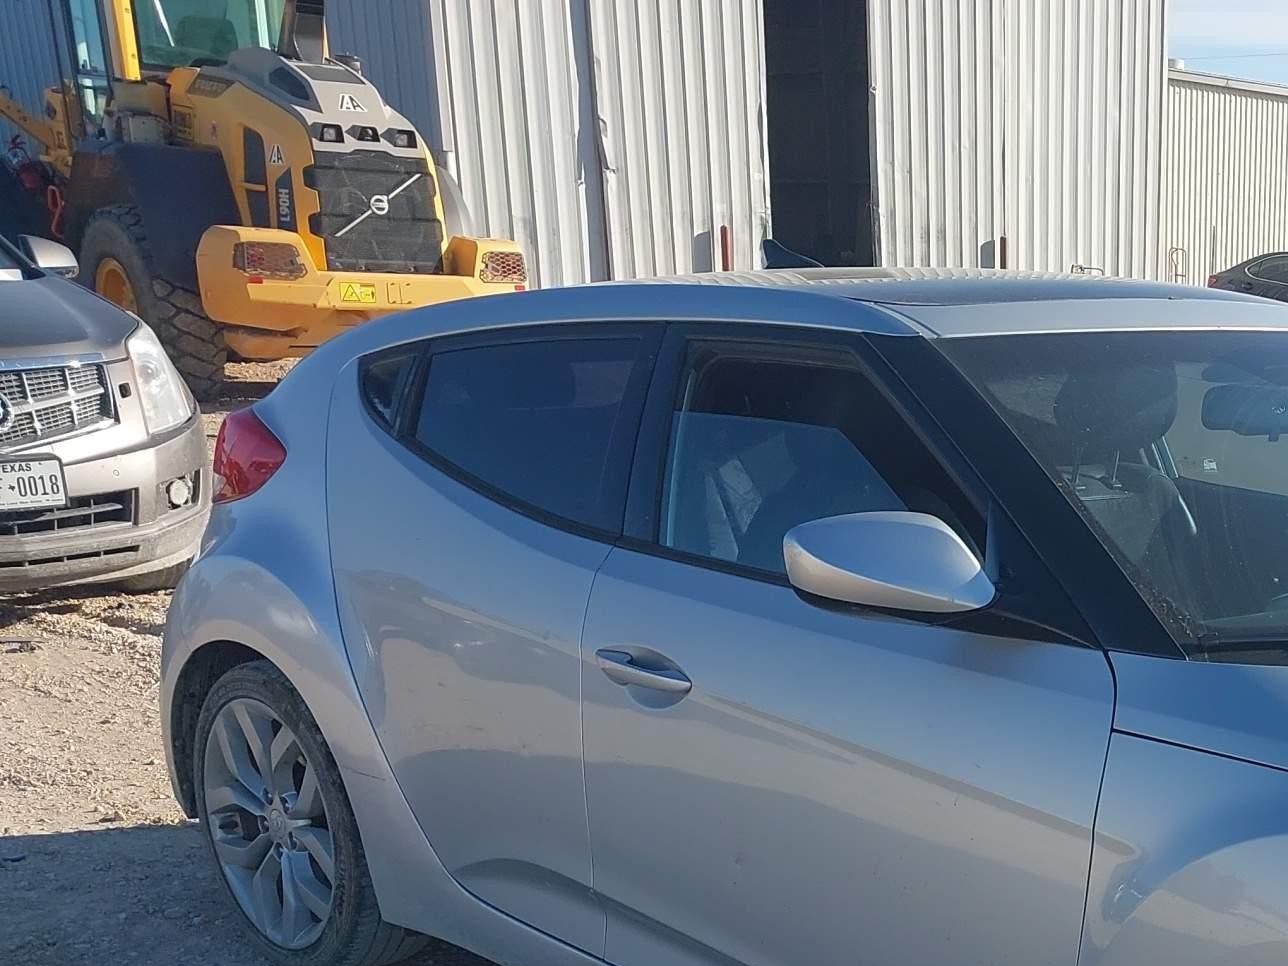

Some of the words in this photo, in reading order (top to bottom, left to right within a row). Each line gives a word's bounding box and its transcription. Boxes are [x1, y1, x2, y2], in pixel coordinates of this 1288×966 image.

[278, 188, 290, 222] L90H
[0, 463, 32, 473] EXAS
[16, 474, 60, 498] 0018
